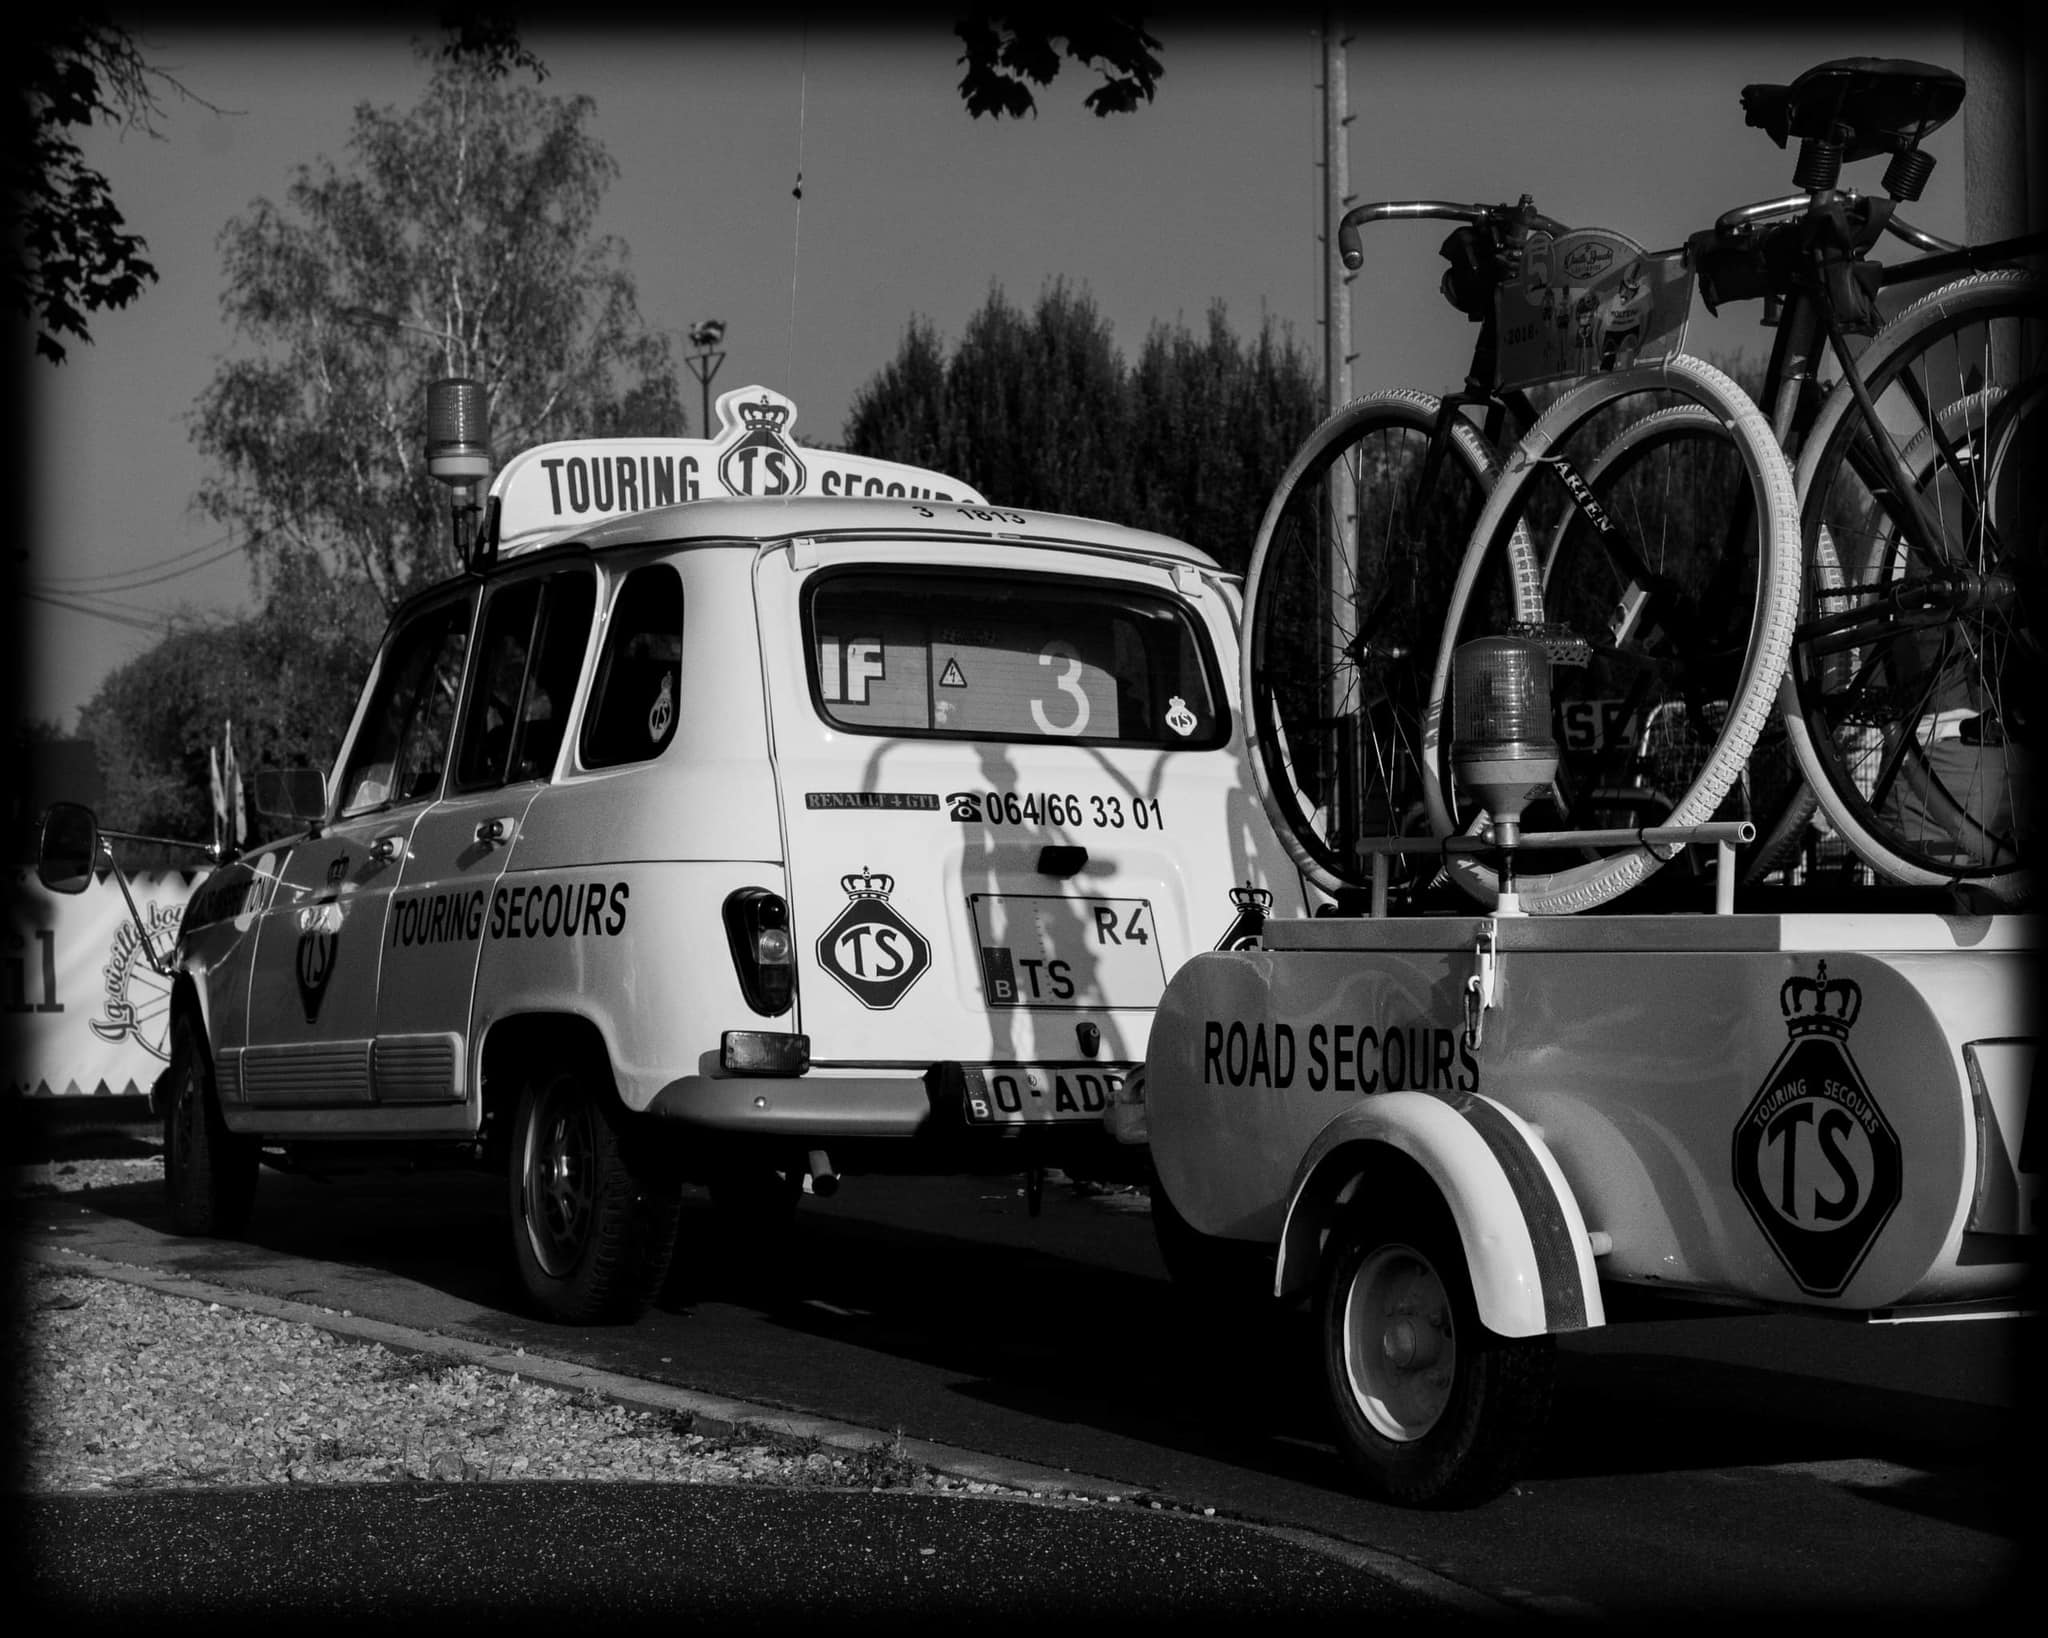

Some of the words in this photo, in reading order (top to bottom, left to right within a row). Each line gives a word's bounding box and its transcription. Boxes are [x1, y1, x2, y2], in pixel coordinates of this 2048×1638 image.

[541, 456, 700, 515] TOURING
[739, 447, 790, 496] TS
[956, 507, 1027, 525] 1813
[1030, 639, 1090, 737] 3
[808, 793, 886, 808] RENAULT
[986, 791, 1082, 827] 064/66
[1090, 795, 1124, 828] 33
[1132, 797, 1163, 830] 01
[393, 890, 484, 947] TOURING
[491, 882, 629, 939] SECOURS
[1094, 906, 1149, 945] R4
[841, 925, 905, 977] TS
[995, 980, 1012, 998] B
[1019, 959, 1075, 999] TS
[1205, 1021, 1295, 1089] ROAD
[1308, 1024, 1480, 1094] SECOURS
[970, 1099, 990, 1118] B
[1753, 1078, 1807, 1129] TOURING
[1823, 1078, 1880, 1136] SECOURS
[1767, 1102, 1859, 1221] TS
